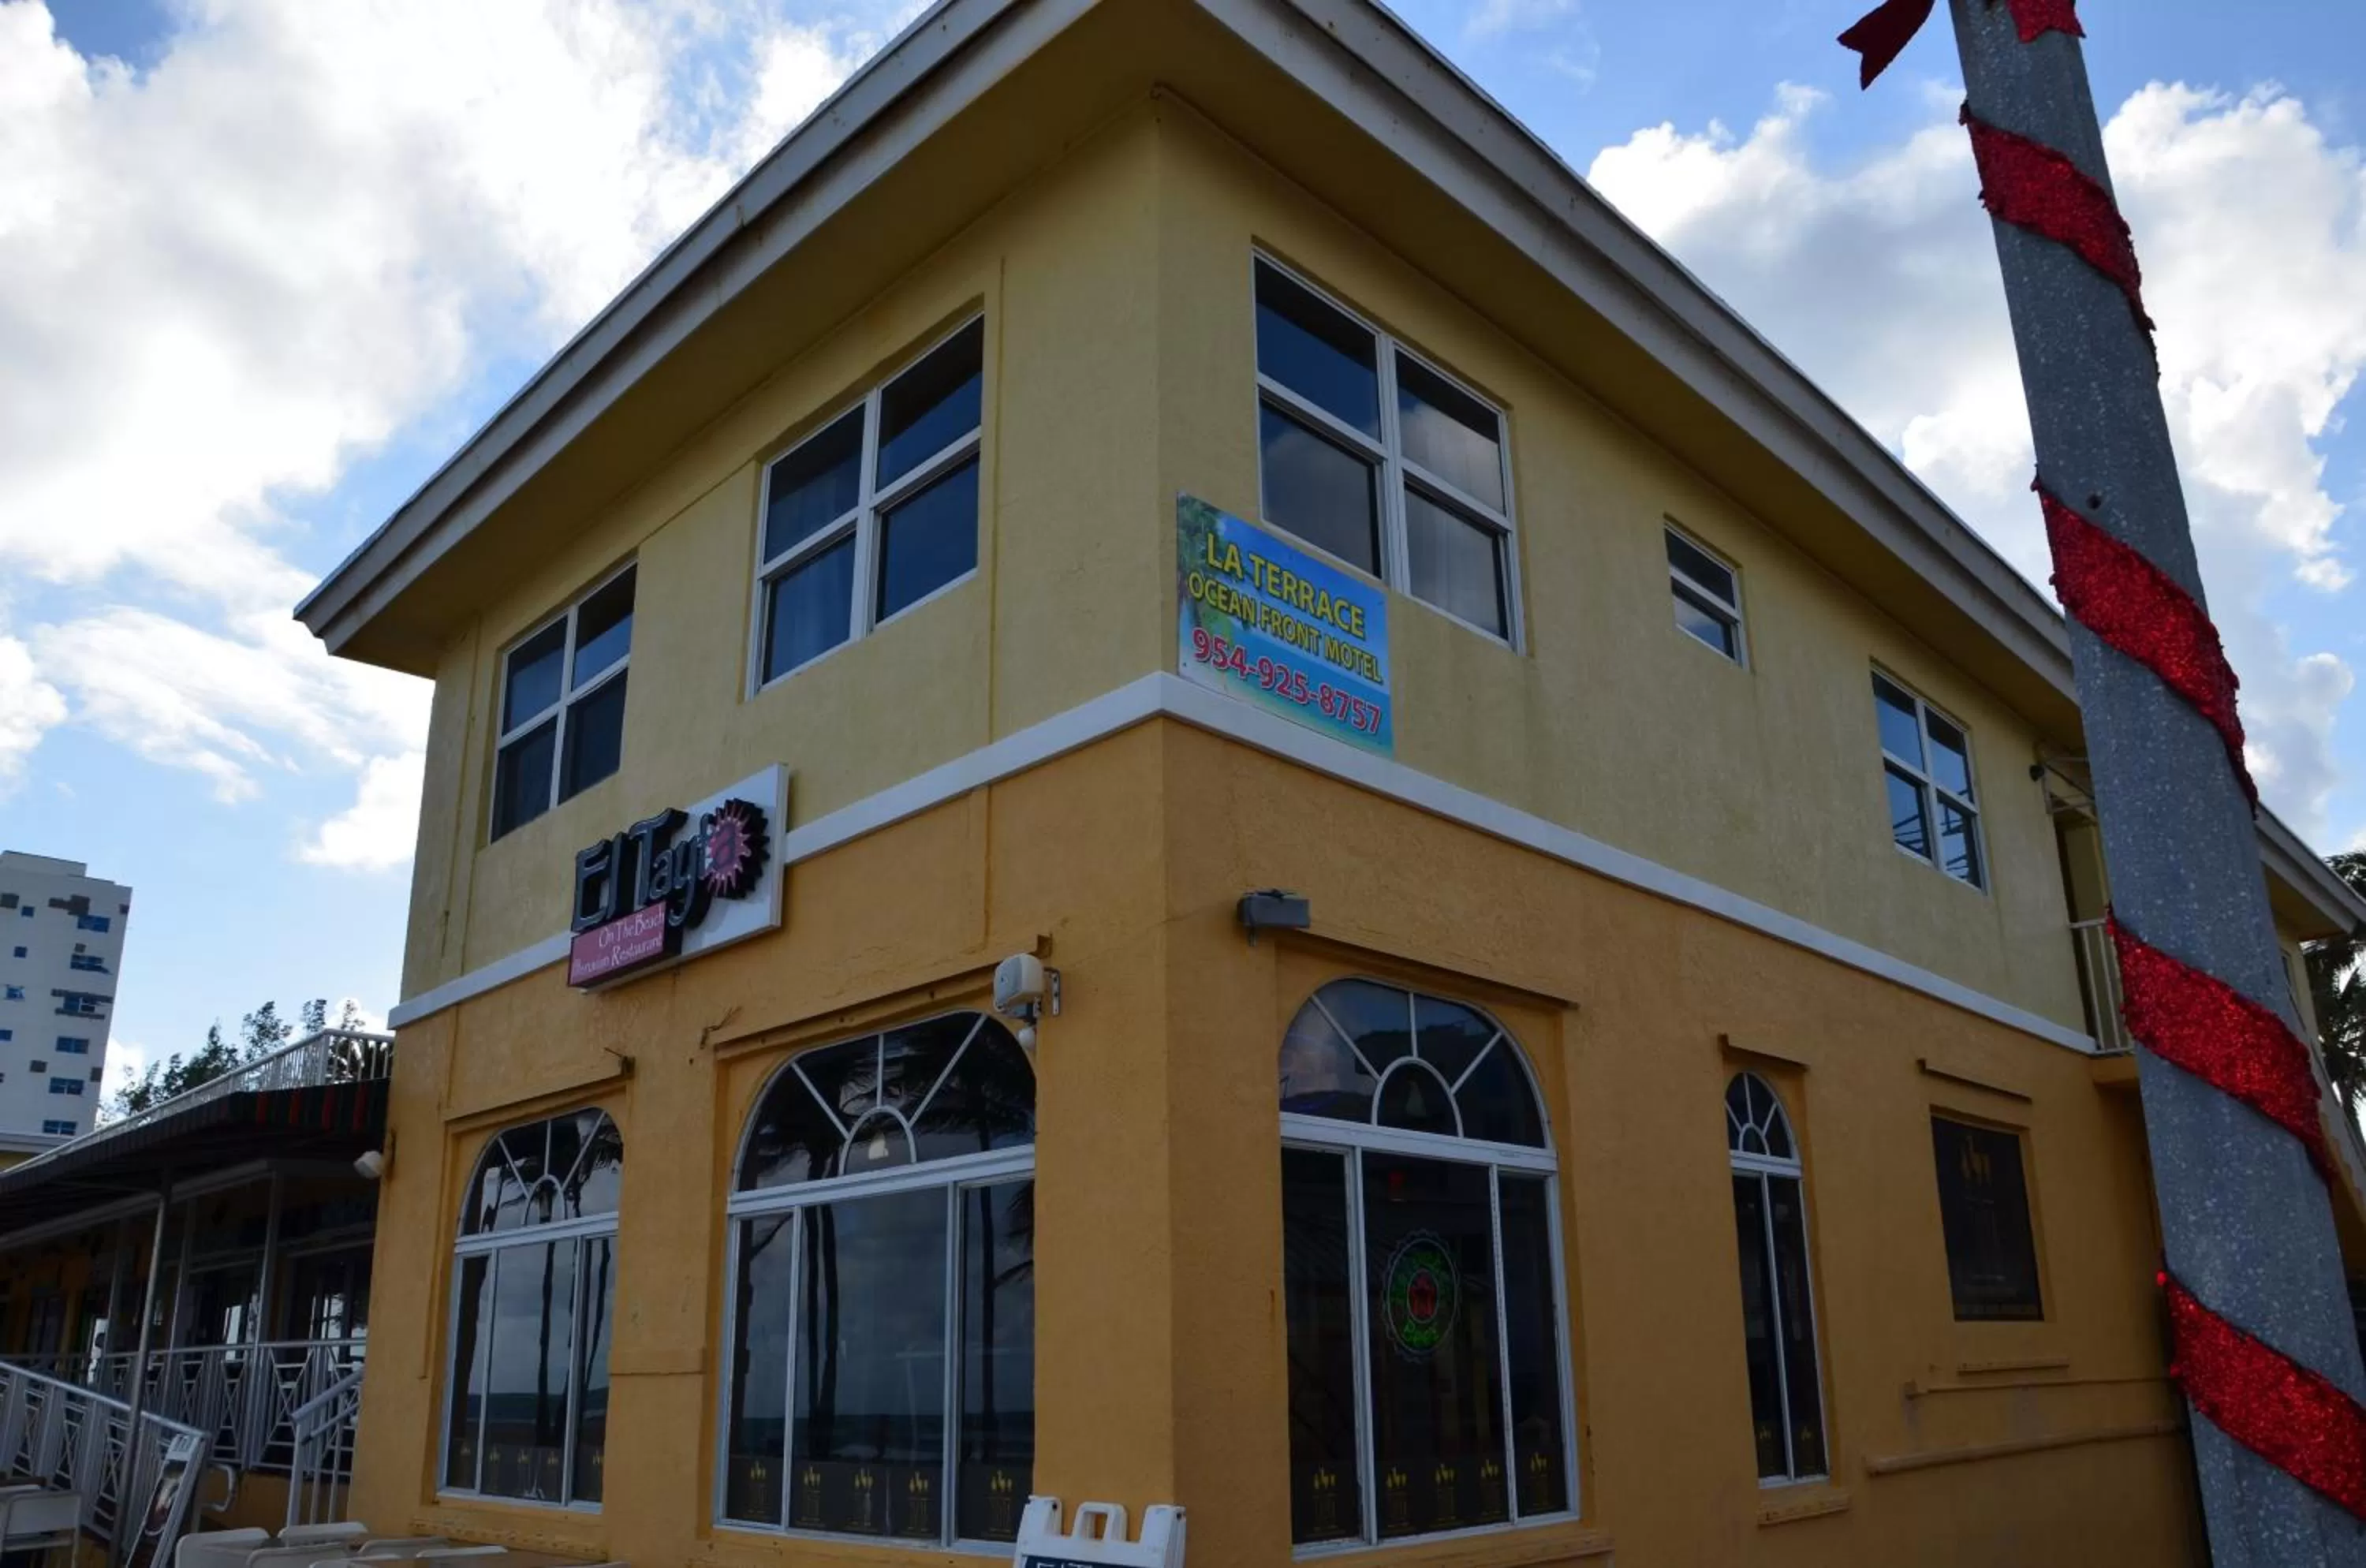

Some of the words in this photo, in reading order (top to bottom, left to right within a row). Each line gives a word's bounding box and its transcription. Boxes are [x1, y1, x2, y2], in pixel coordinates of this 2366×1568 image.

[1188, 572, 1256, 628] OCEAN
[1260, 604, 1321, 655] FRONT
[1324, 634, 1383, 685] MOTEL
[1206, 532, 1244, 579] LA
[1249, 553, 1365, 640] TERRACE
[1192, 627, 1382, 735] 954-925-8757
[572, 832, 625, 931] El
[599, 927, 614, 947] On
[614, 918, 633, 942] The
[634, 904, 665, 936] Beach
[611, 931, 662, 967] Restaurant
